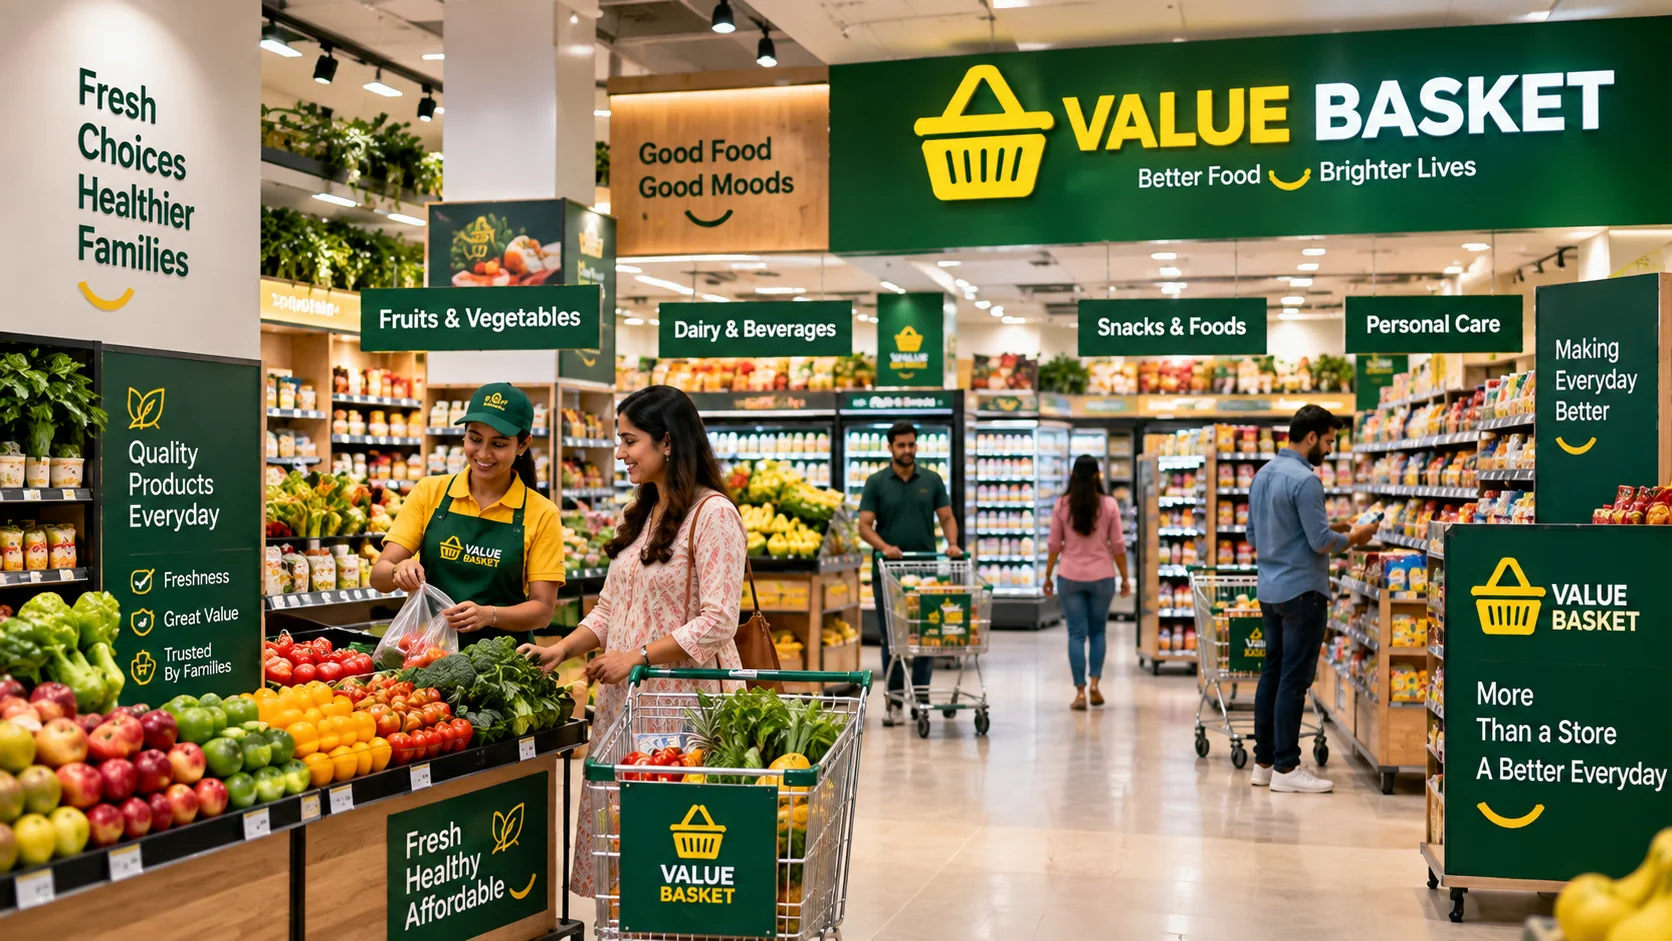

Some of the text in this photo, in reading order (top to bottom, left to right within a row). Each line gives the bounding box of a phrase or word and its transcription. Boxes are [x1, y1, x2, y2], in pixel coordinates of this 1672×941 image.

[80, 68, 156, 124] Fresh
[1062, 70, 1614, 151] VALUE BASKET
[78, 123, 186, 181] Choices
[639, 137, 771, 165] Good Food
[639, 171, 794, 198] Good Moods
[1139, 157, 1476, 188] Better Food Brighter Lives
[79, 174, 194, 230] Healthier
[79, 225, 188, 277] Families
[380, 306, 580, 332] Fruits & Vegetables
[675, 320, 836, 342] Dairy & Beverages
[1098, 316, 1246, 336] Snacks & Foods
[1367, 314, 1500, 333] Personal Care
[1556, 337, 1618, 363] Making
[1556, 369, 1637, 394] Everyday
[1556, 401, 1610, 421] Better
[129, 440, 198, 469] Quality
[130, 472, 213, 495] Products
[130, 503, 219, 531] Everyday
[463, 554, 500, 567] BASKET
[466, 544, 502, 559] VALUE
[165, 570, 229, 588] Freshness
[1552, 584, 1627, 606] VALUE
[164, 606, 238, 627] Great Value
[1553, 610, 1640, 631] BASKET
[165, 643, 211, 661] Trusted
[165, 660, 231, 683] By Families
[1478, 681, 1533, 706] More
[1476, 718, 1616, 744] Than a Store
[1476, 757, 1667, 791] A Better Everyday
[407, 821, 461, 859] Fresh
[406, 852, 482, 895] Healthy
[661, 865, 734, 885] VALUE
[404, 873, 505, 931] Affordable
[661, 886, 735, 904] BASKET
